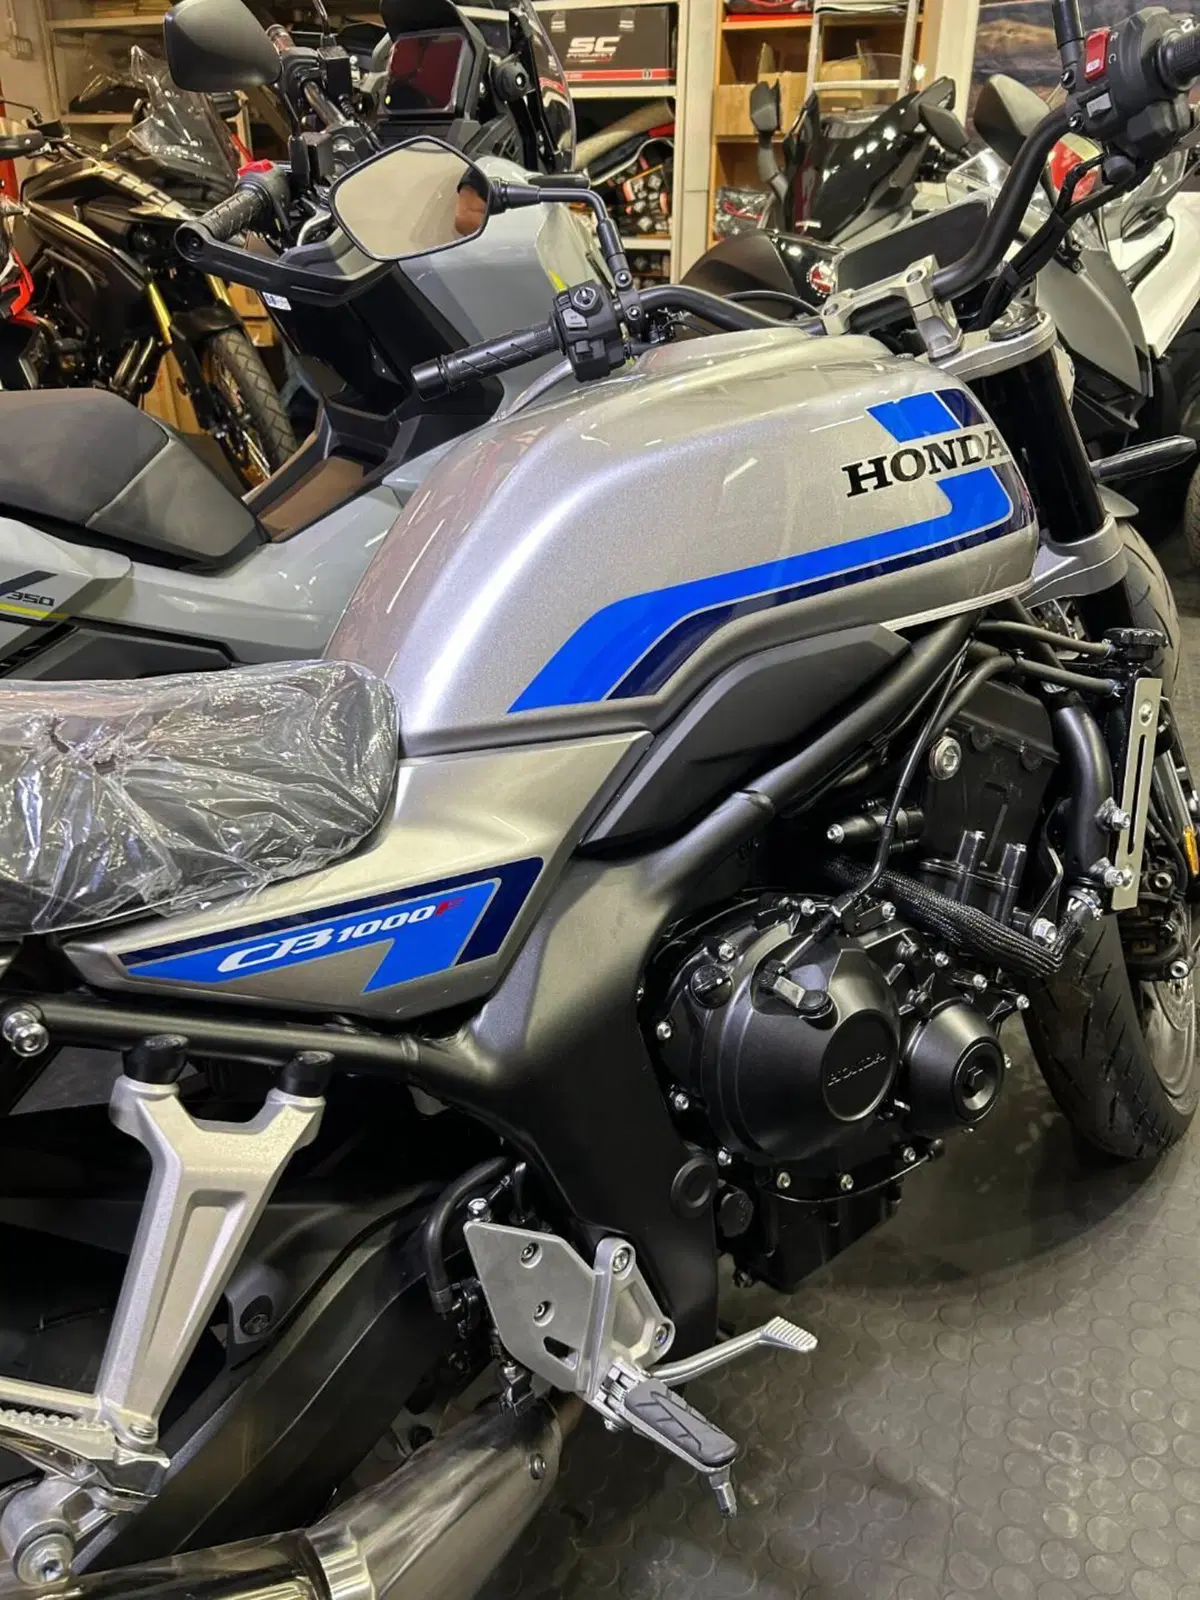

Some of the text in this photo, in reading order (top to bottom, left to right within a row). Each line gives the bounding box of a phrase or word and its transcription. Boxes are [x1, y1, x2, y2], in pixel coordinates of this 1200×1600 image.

[567, 35, 621, 54] SC
[842, 429, 1009, 498] HONDA
[6, 591, 56, 607] 350
